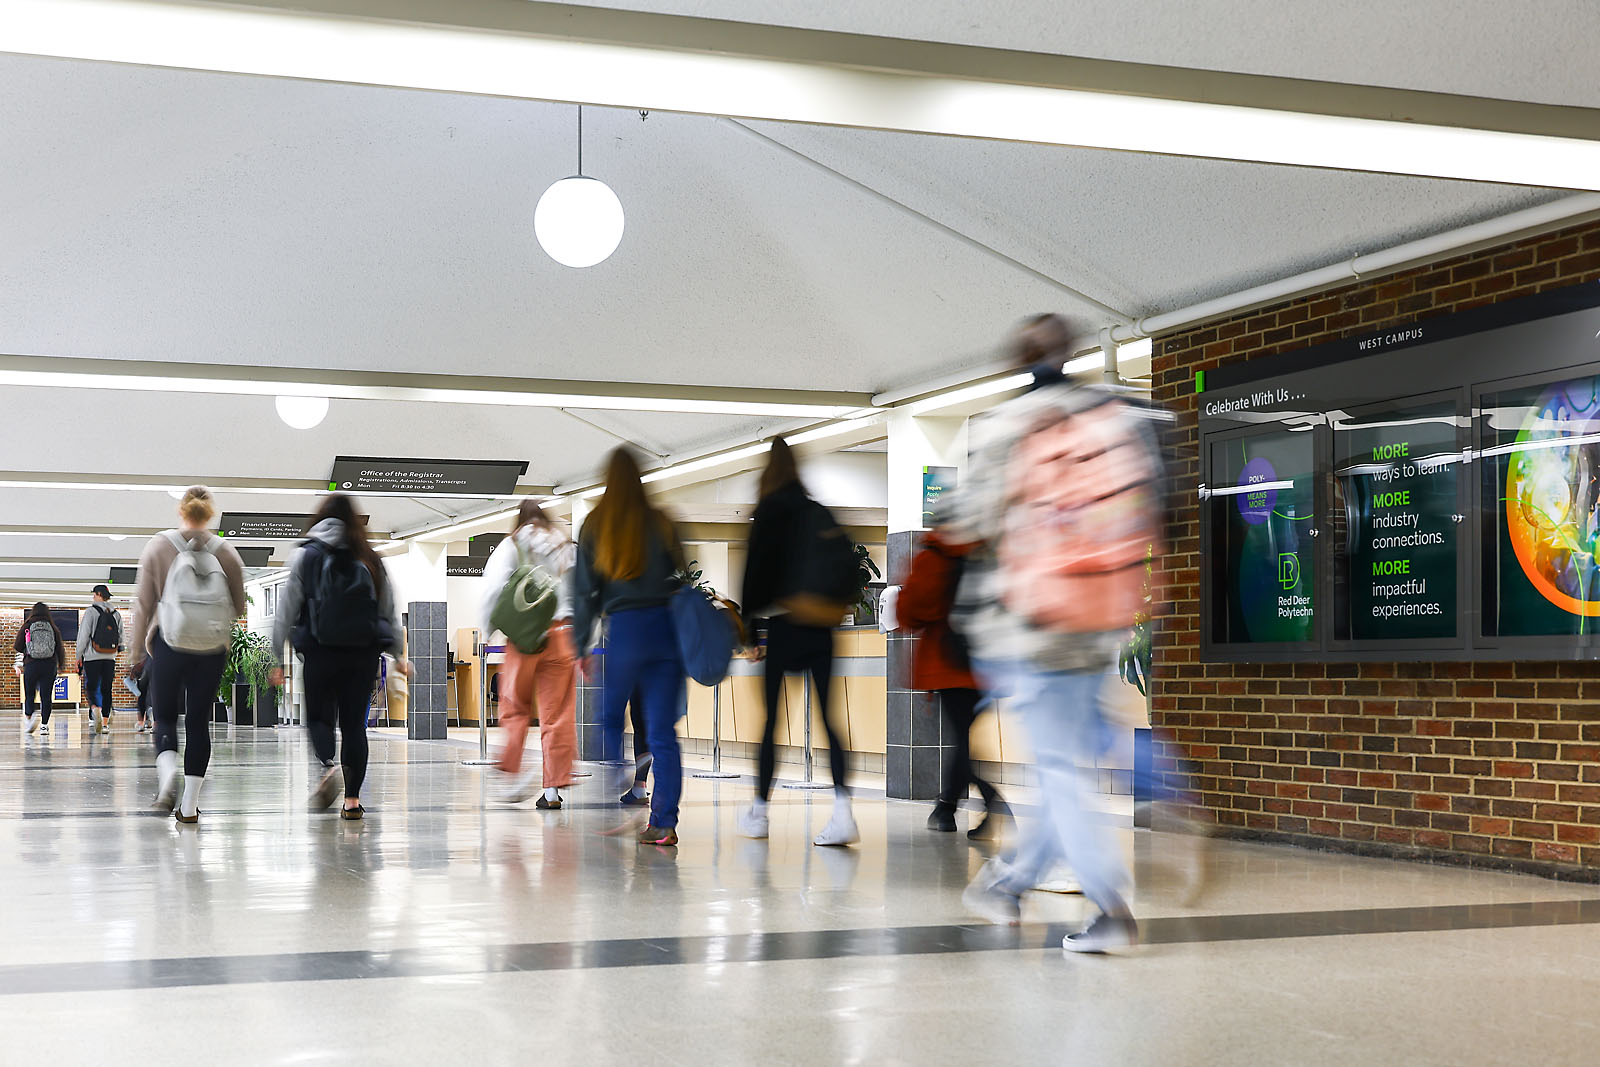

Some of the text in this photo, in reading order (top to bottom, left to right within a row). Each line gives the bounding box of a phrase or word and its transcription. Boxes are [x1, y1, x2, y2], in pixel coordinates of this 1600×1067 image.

[1359, 328, 1423, 350] WEST CAMPUS
[1206, 397, 1249, 416] Celebrate
[1251, 391, 1274, 407] With
[1373, 442, 1409, 461] MORE
[1248, 474, 1265, 483] POLY-
[1373, 467, 1400, 483] ways
[1402, 463, 1415, 478] to
[1247, 491, 1267, 500] MEANS
[1248, 499, 1266, 508] MORE
[1373, 490, 1410, 509] MORE
[1373, 512, 1419, 529] industry
[1372, 530, 1445, 549] connections.
[1372, 560, 1410, 576] MORE
[1372, 578, 1426, 600] impactful
[1278, 595, 1311, 606] Red Deer
[1372, 600, 1442, 621] experiences.
